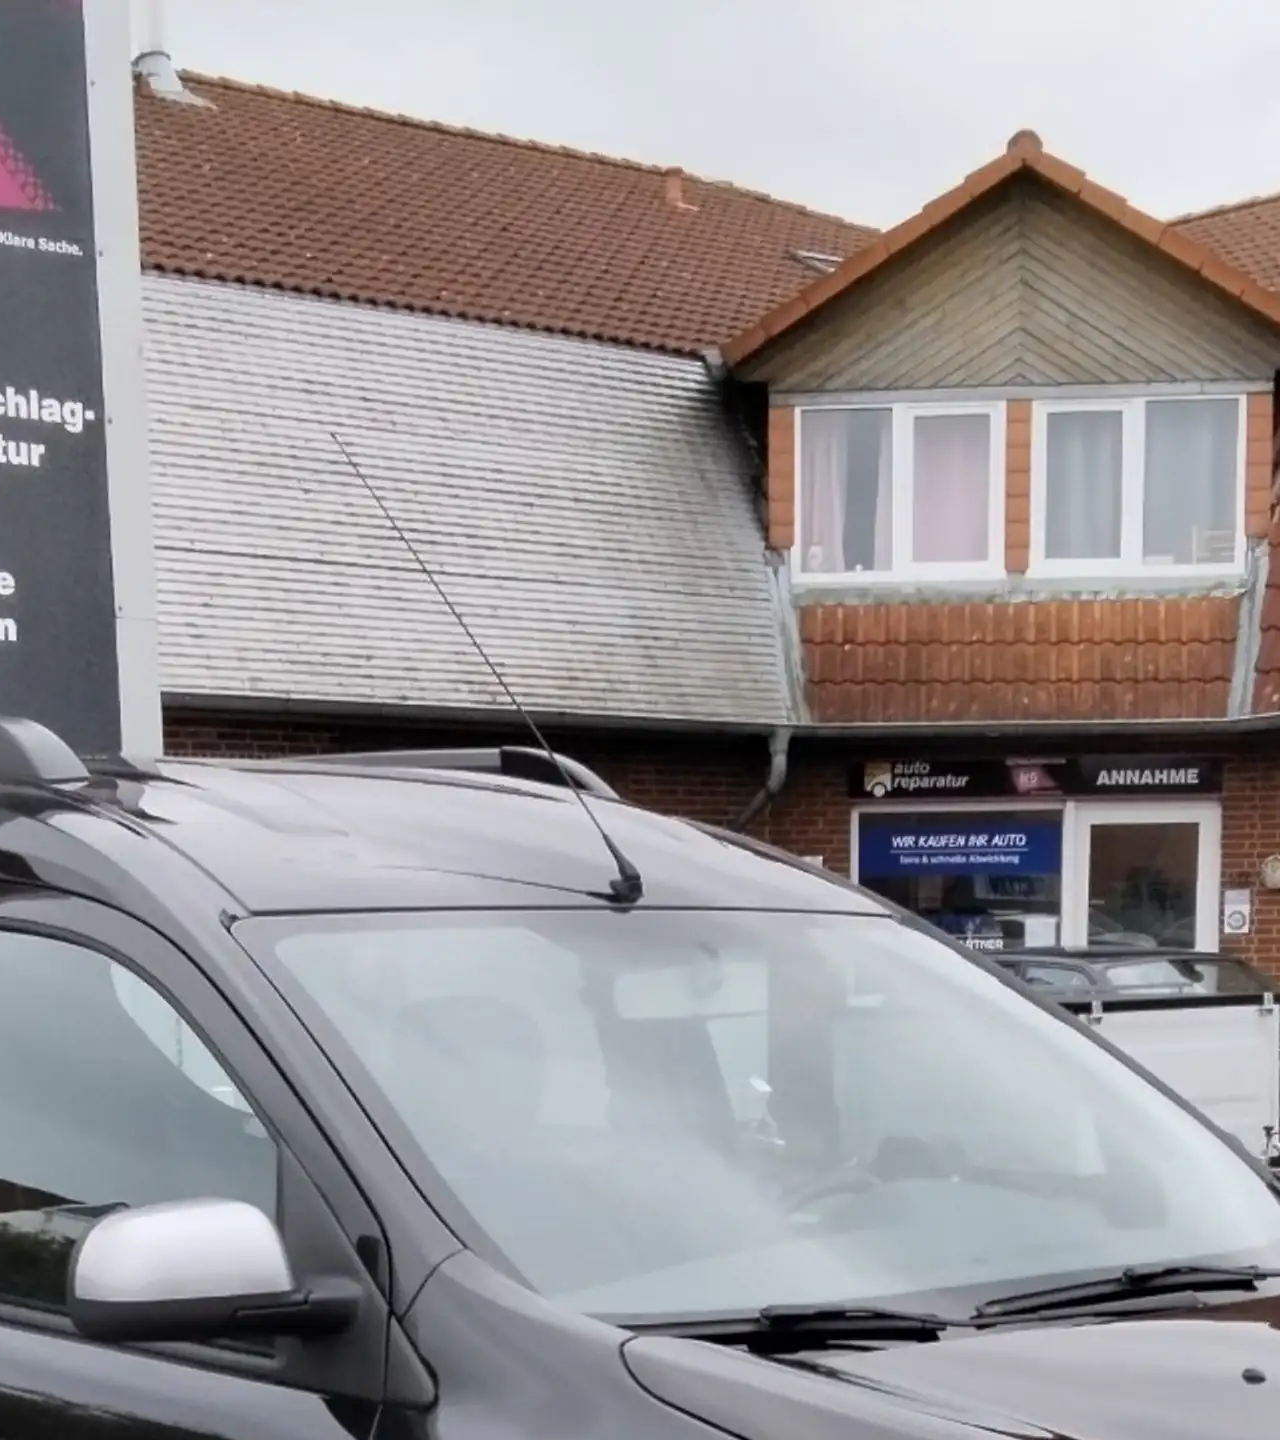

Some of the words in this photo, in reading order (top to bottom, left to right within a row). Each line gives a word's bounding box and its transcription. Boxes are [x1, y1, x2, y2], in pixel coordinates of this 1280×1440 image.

[38, 237, 83, 256] Sache.
[894, 761, 931, 774] auto
[892, 774, 969, 791] reparatur
[1095, 767, 1200, 786] ANNAHME
[891, 835, 915, 848] WIR
[918, 834, 966, 848] KAUFEN
[967, 834, 989, 847] IHR
[991, 833, 1027, 847] AUTO
